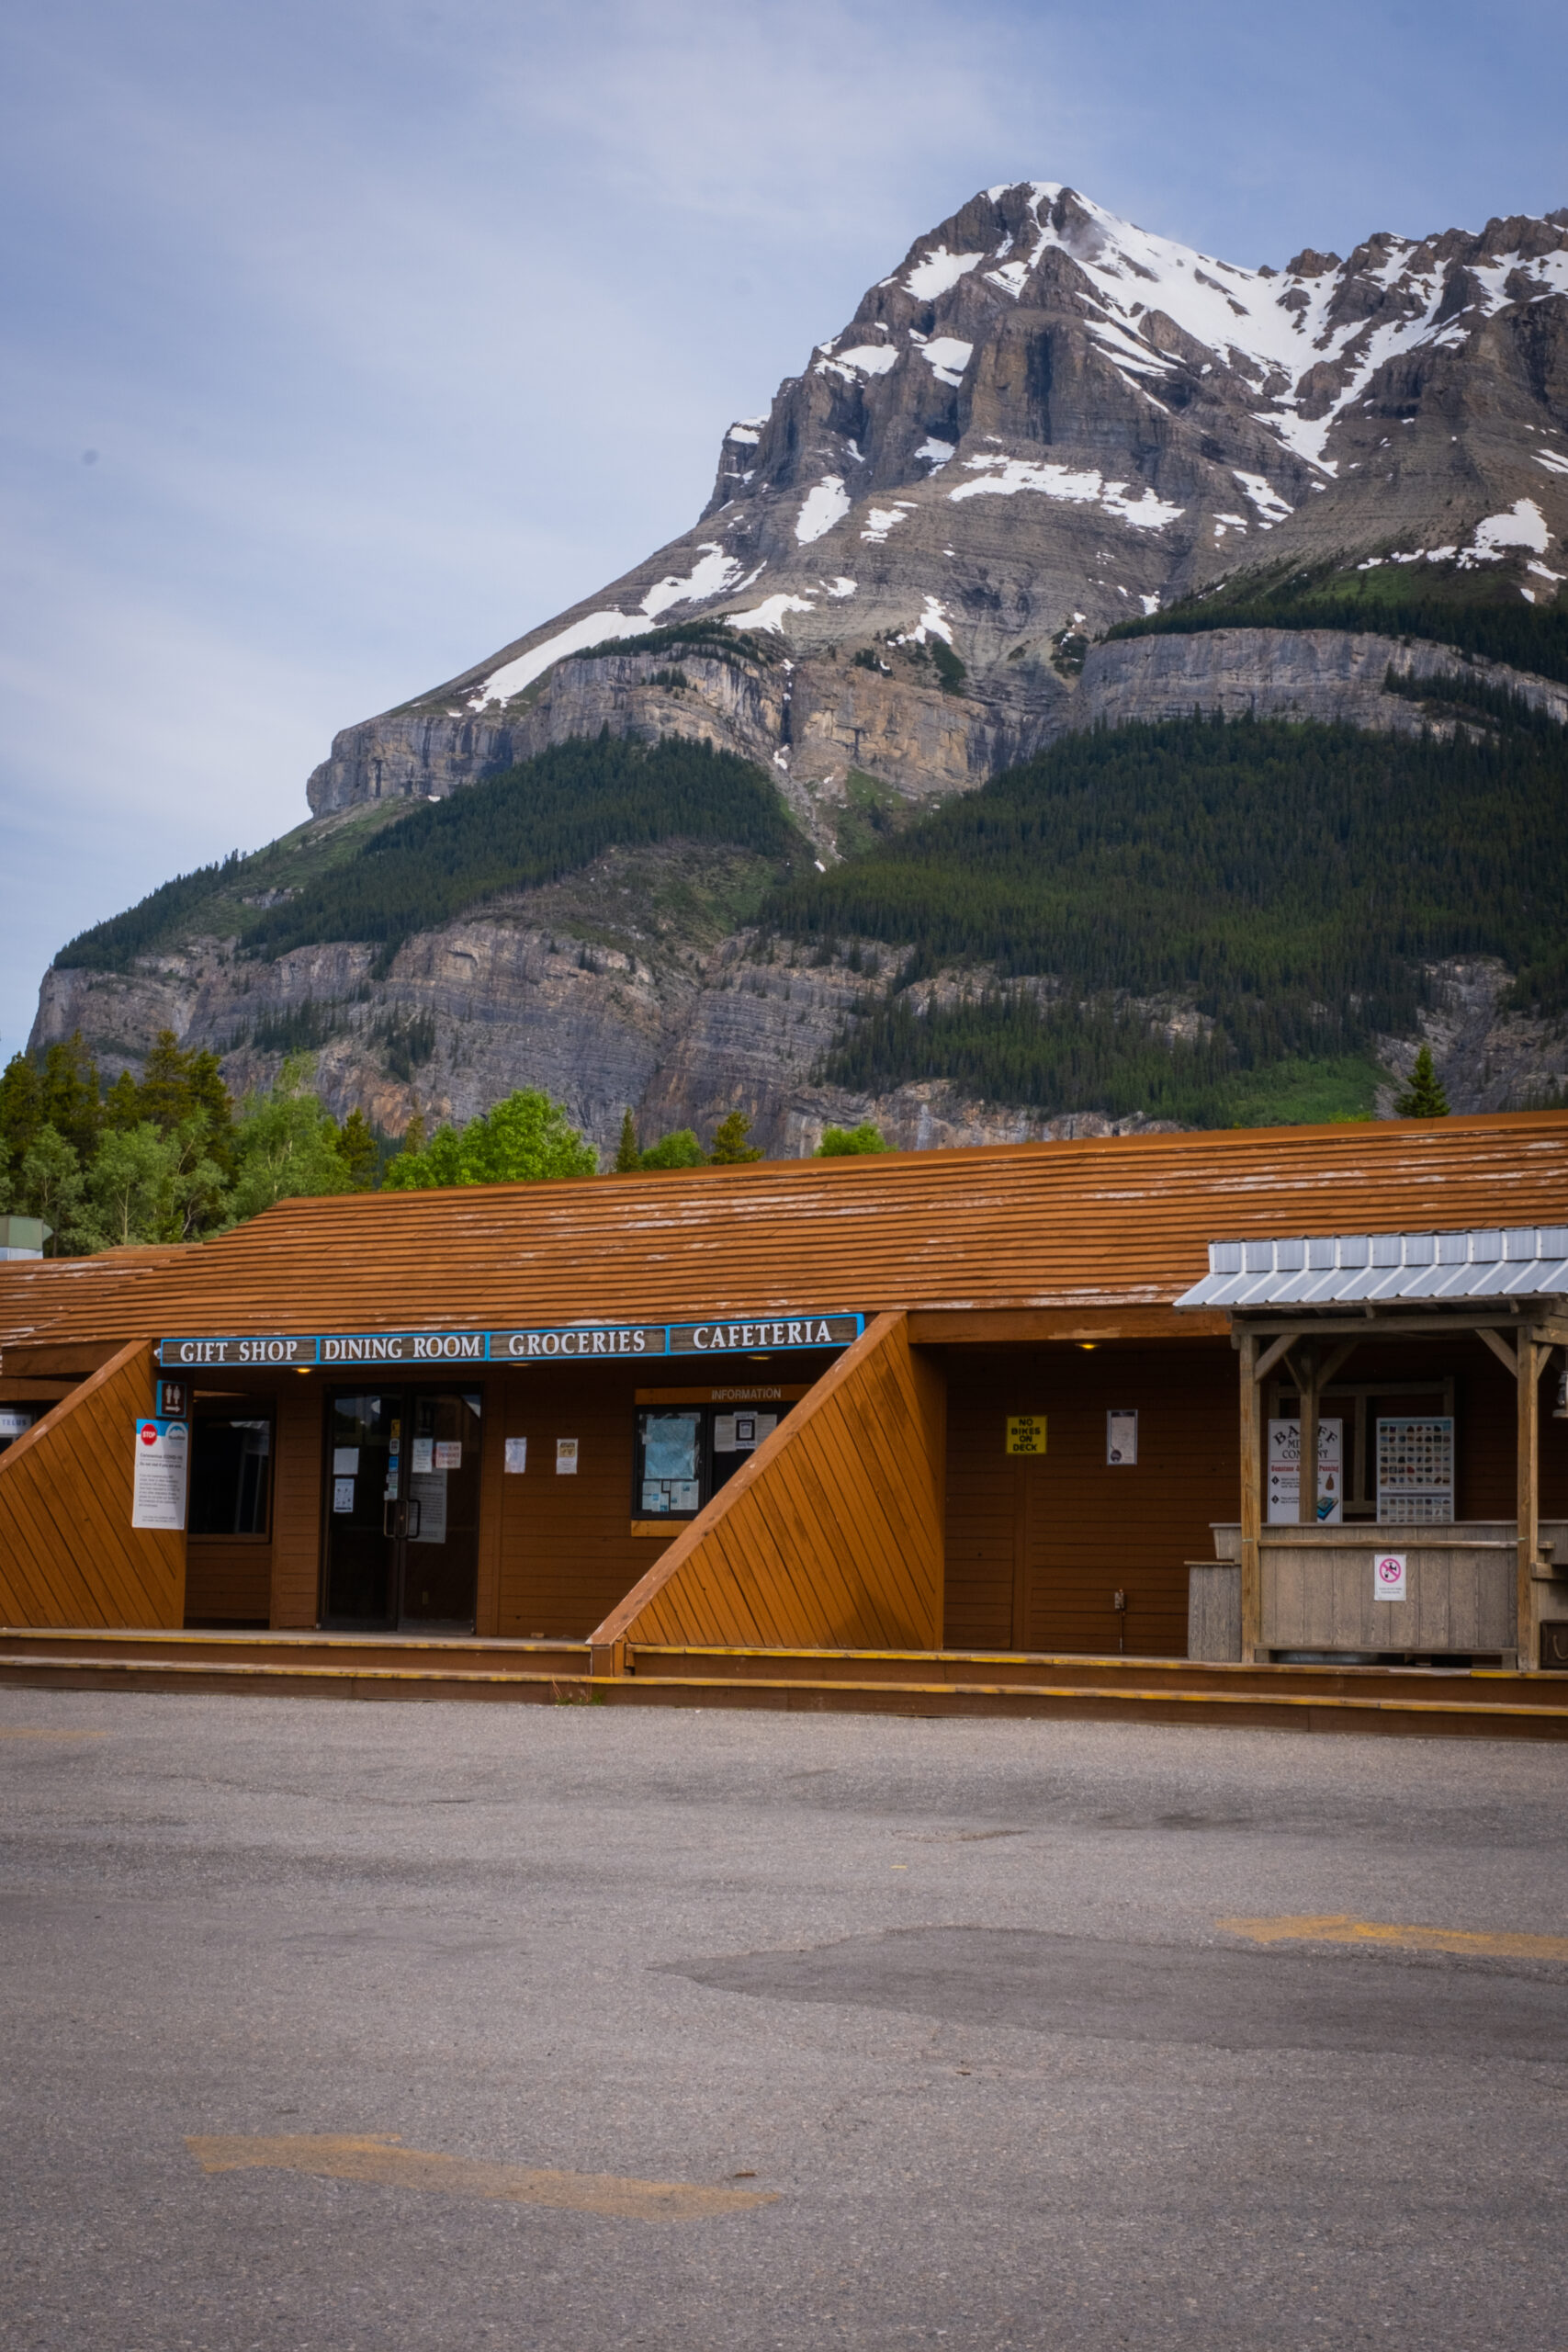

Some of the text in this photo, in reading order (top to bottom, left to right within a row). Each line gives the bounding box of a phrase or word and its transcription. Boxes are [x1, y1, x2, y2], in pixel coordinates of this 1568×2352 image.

[693, 1320, 832, 1350] CAFETERIA
[324, 1336, 480, 1361] DINING ROOM
[508, 1330, 646, 1356] GROCERIES
[180, 1340, 299, 1363] GIFT SHOP
[711, 1387, 782, 1400] INFORMATION
[1019, 1418, 1033, 1426] NO
[142, 1430, 156, 1439] STOP
[1010, 1427, 1041, 1435] BIKES
[1272, 1425, 1337, 1446] BAFF
[1019, 1435, 1032, 1443] ON
[1013, 1443, 1037, 1452] DECK
